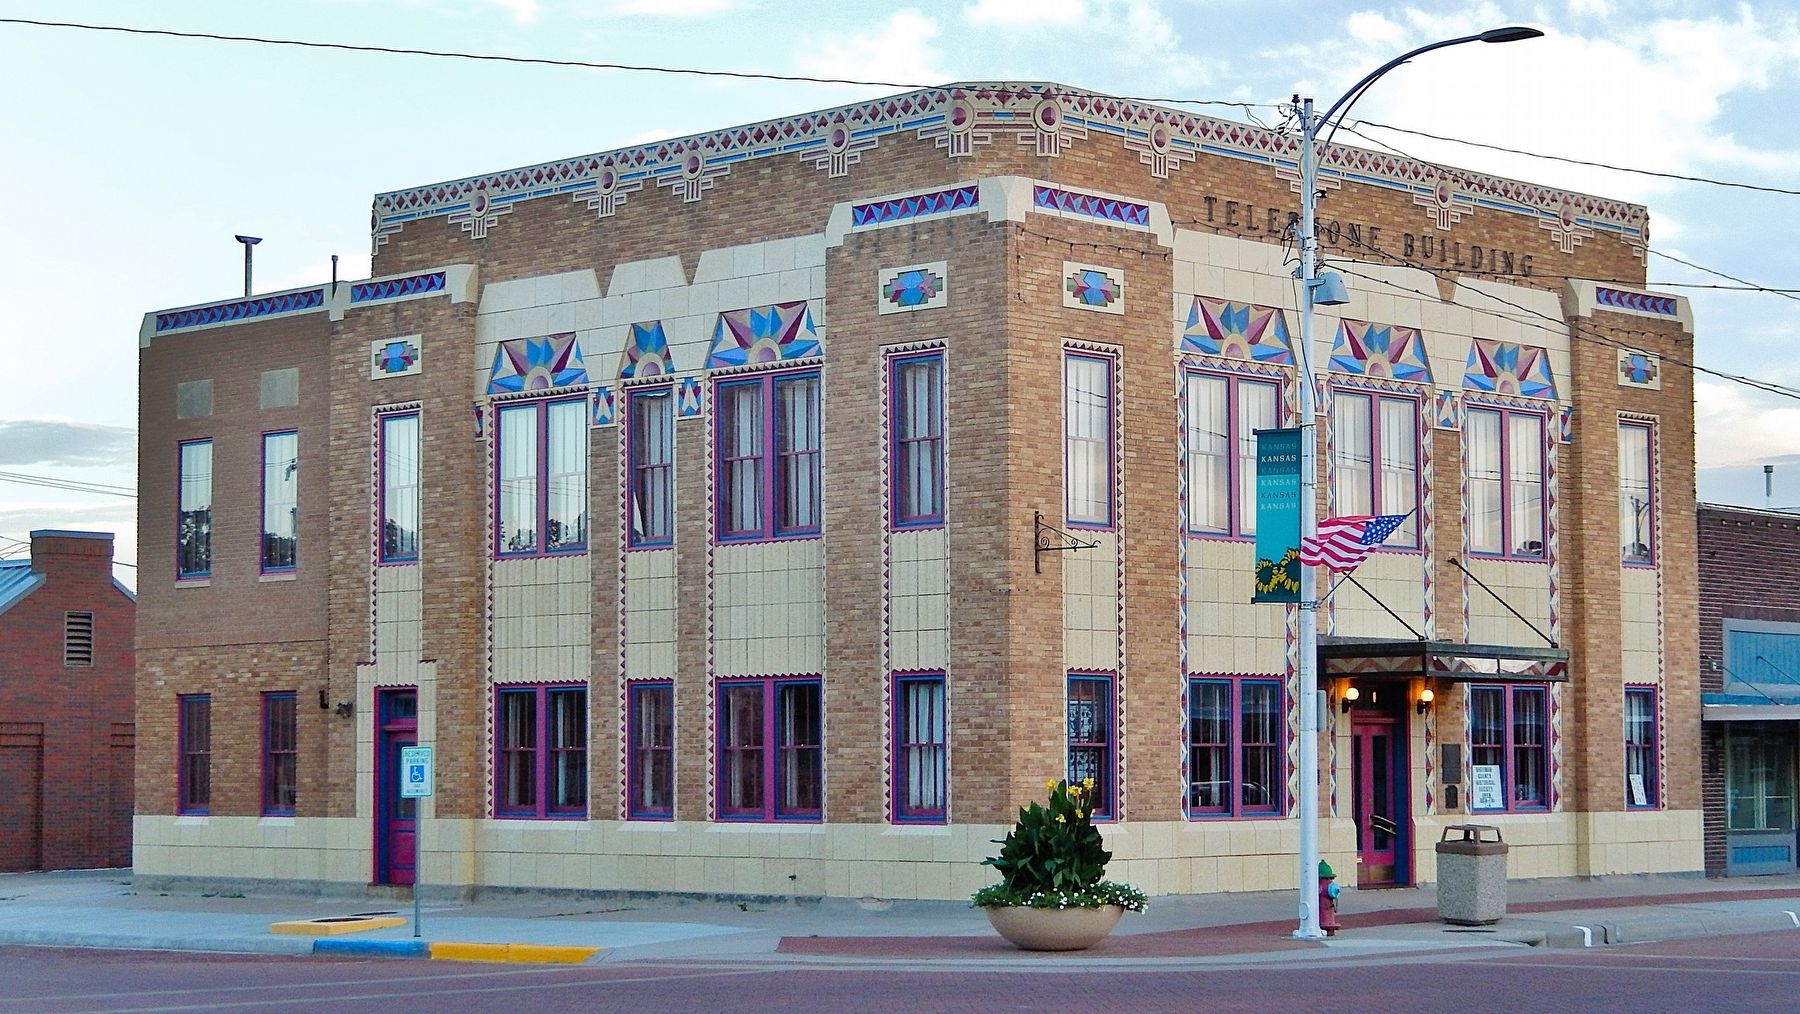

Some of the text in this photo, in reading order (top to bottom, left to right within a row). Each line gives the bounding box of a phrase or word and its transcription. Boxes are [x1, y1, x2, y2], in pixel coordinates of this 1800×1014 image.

[1403, 232, 1534, 278] BUILDING
[1261, 455, 1297, 463] KANSAS
[1261, 479, 1297, 487] KANSAS
[1260, 491, 1297, 499] KANSAS
[1260, 502, 1297, 510] KANSAS
